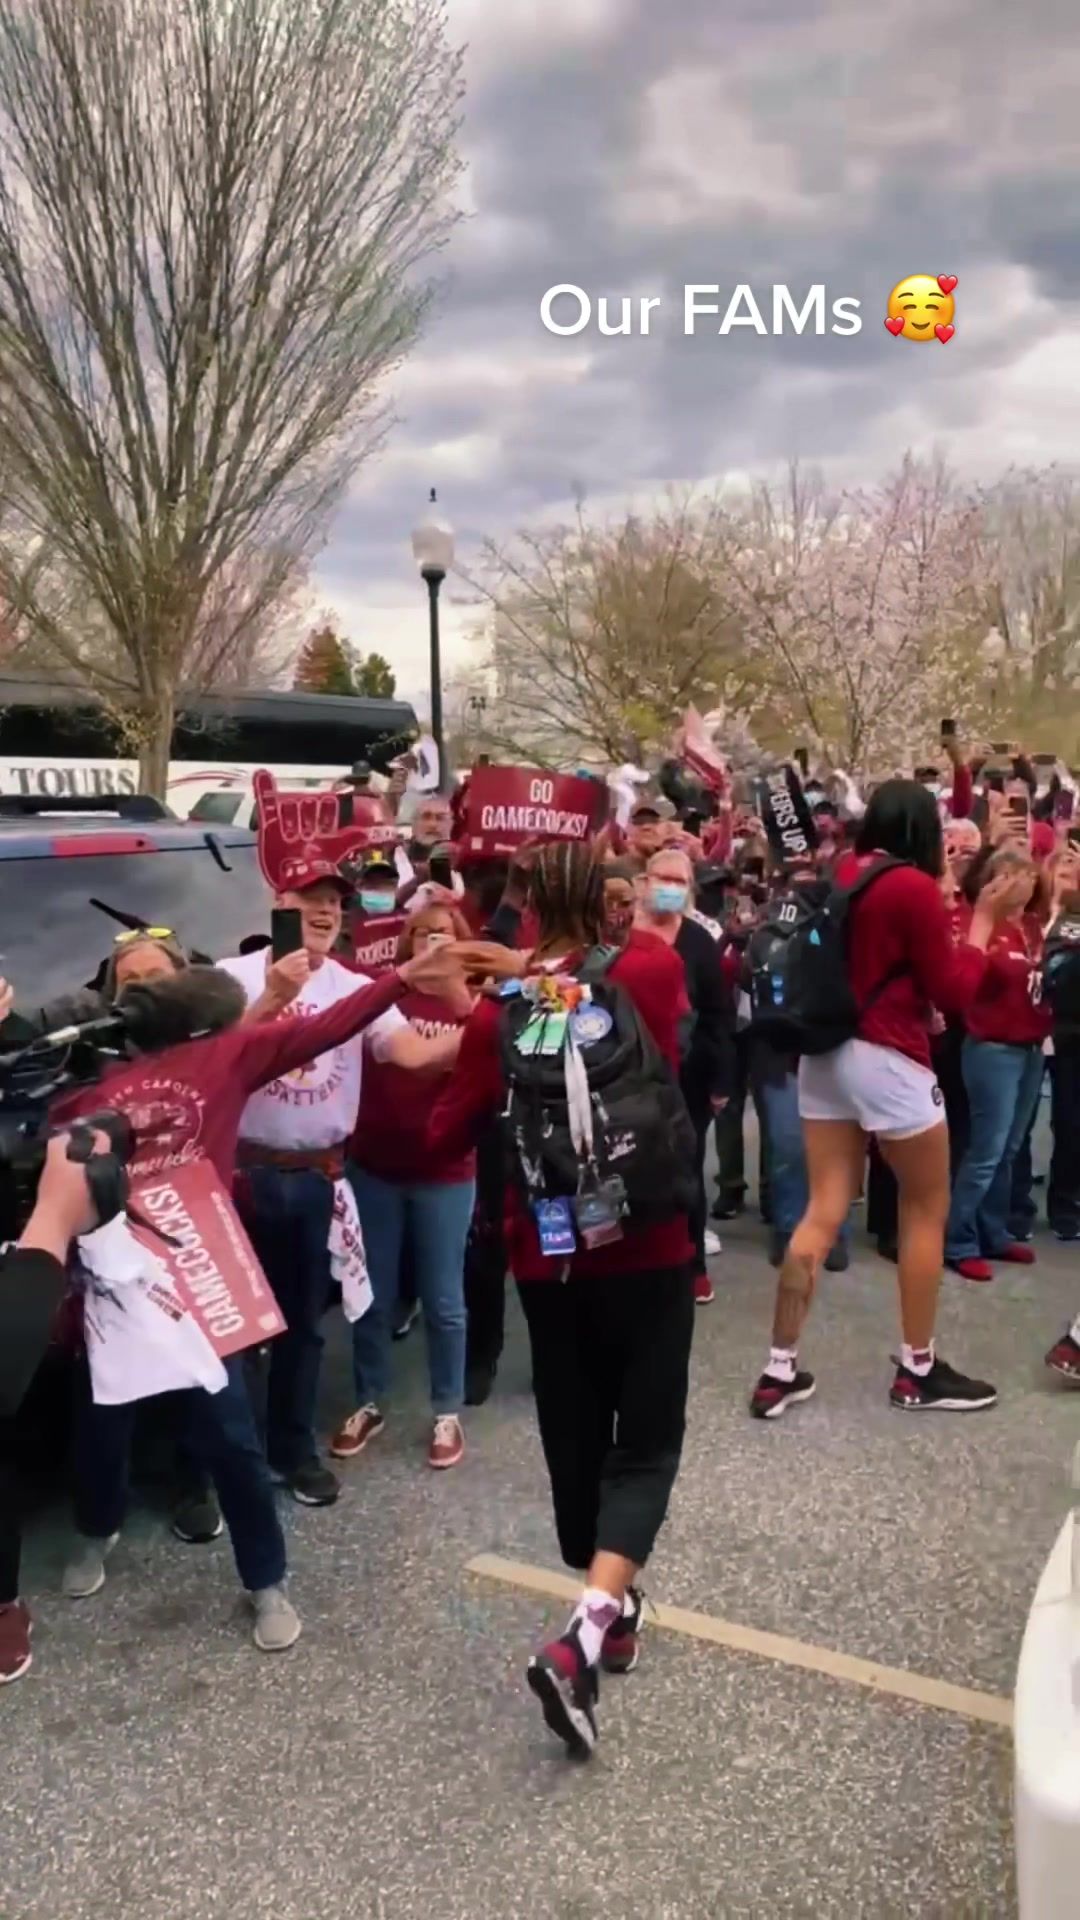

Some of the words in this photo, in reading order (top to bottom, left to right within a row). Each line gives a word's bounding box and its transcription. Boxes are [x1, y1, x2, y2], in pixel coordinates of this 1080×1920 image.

[10, 767, 136, 797] TOURS
[530, 778, 554, 804] GO
[481, 804, 589, 838] GAMECOCKS!
[779, 902, 798, 923] 10
[139, 1182, 245, 1338] GAMECOCKS!
